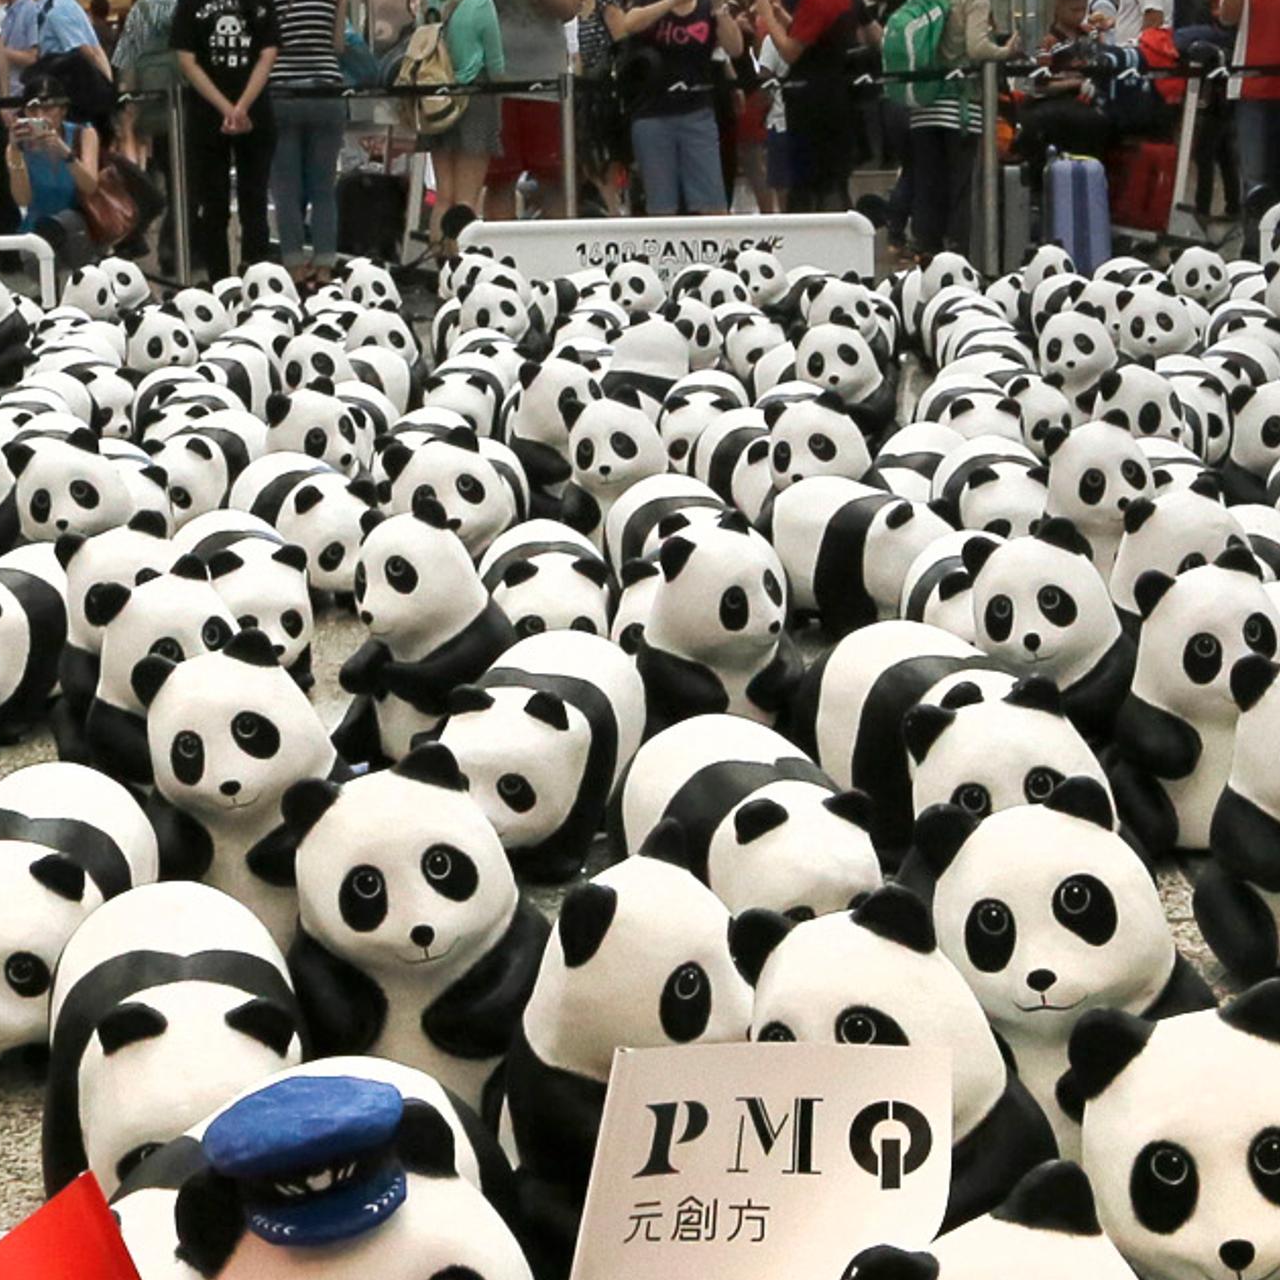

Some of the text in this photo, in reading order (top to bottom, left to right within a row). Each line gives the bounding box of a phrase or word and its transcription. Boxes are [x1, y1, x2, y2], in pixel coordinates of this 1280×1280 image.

[575, 241, 637, 266] 1600
[631, 1096, 934, 1190] PMQ
[623, 1194, 771, 1243] 元創方
